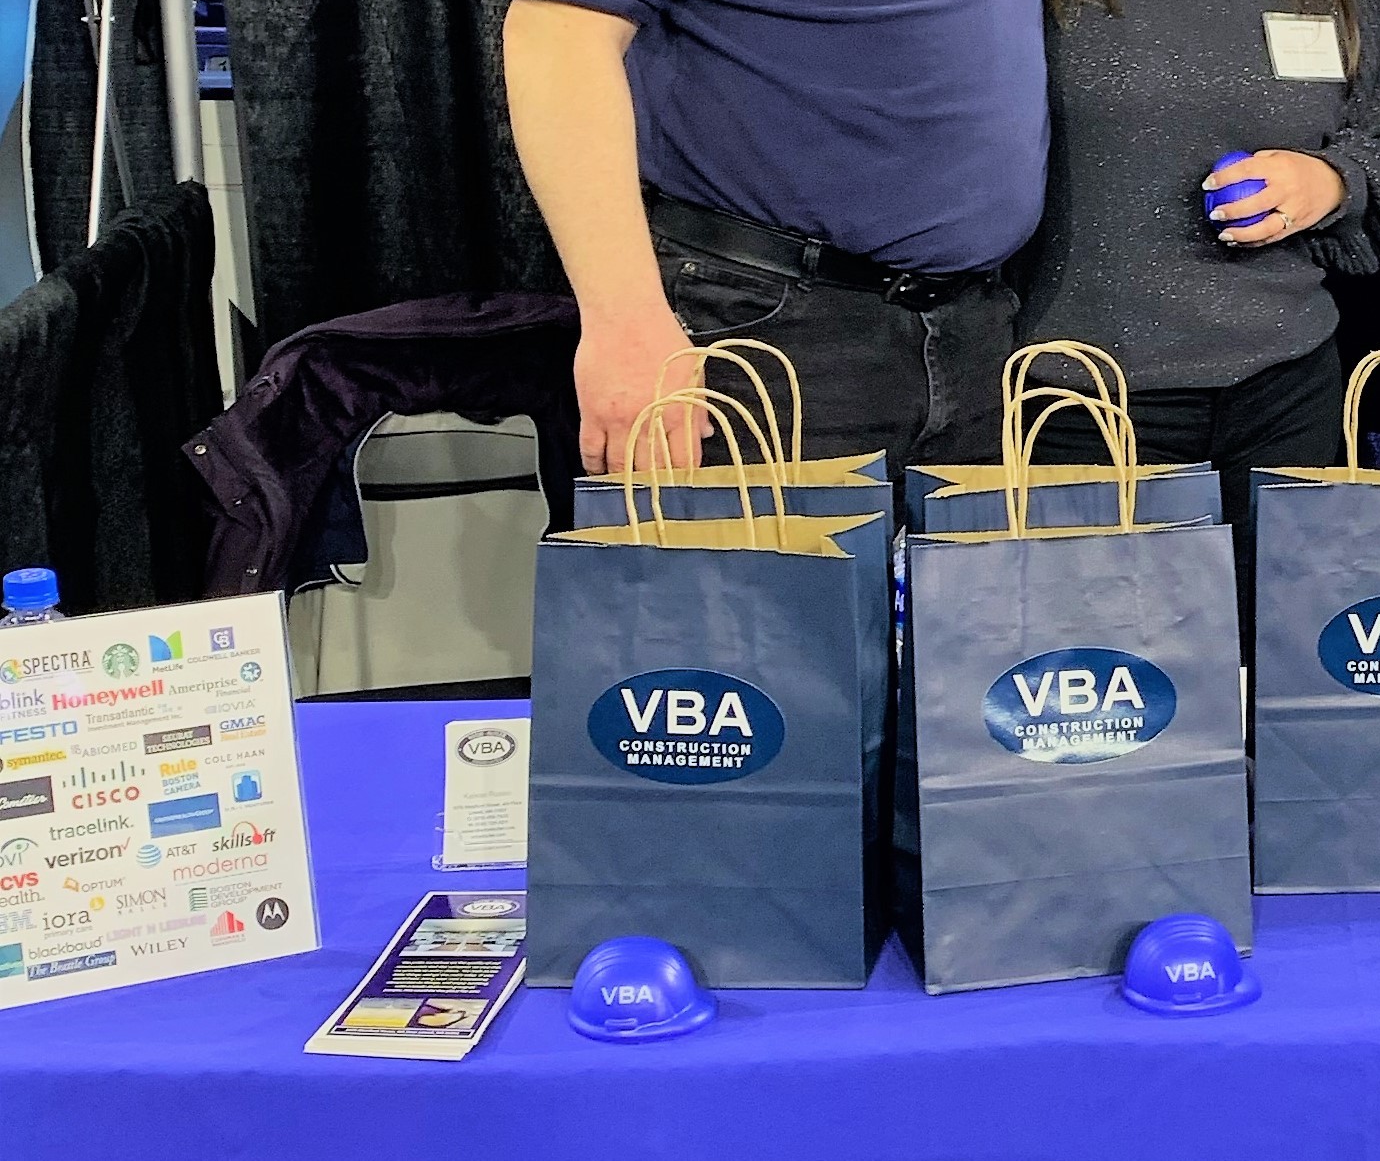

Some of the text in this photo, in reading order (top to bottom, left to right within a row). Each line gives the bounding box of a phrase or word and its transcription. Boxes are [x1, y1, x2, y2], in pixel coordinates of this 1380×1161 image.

[22, 649, 92, 676] SPECTRA
[187, 647, 261, 665] COLDWELL BANKER
[152, 663, 184, 674] MetLife
[51, 679, 164, 711] Honeywell
[168, 677, 238, 697] Ameriprise
[1012, 666, 1146, 717] VBA
[85, 705, 155, 725] Transatlantic
[219, 714, 266, 731] GMAC
[620, 687, 754, 738] VBA
[0, 720, 78, 745] FESTO
[1014, 716, 1145, 738] CONSTRUCTION
[81, 741, 138, 758] ABIOMED
[468, 741, 506, 756] VBA
[618, 739, 752, 756] CONSTRUCTION
[1022, 729, 1137, 751] MANAGEMENT
[204, 749, 266, 765] COLE HAAN
[626, 752, 744, 769] MANAGEMENT
[160, 758, 197, 777] Rule
[162, 772, 200, 787] BOSTON
[163, 781, 201, 796] CAMERA
[72, 786, 140, 810] CISCO
[44, 843, 122, 869] verizon
[165, 843, 197, 858] AT&T
[173, 853, 268, 881] moderna
[0, 871, 39, 891] CVS
[81, 878, 123, 893] OPTUM
[210, 881, 252, 894] BOSTON
[116, 887, 167, 911] SIMON
[43, 910, 92, 931] iora
[28, 936, 103, 960] blackbaud
[130, 936, 189, 957] WILEY
[1164, 961, 1217, 984] VBA
[600, 984, 655, 1006] VBA
